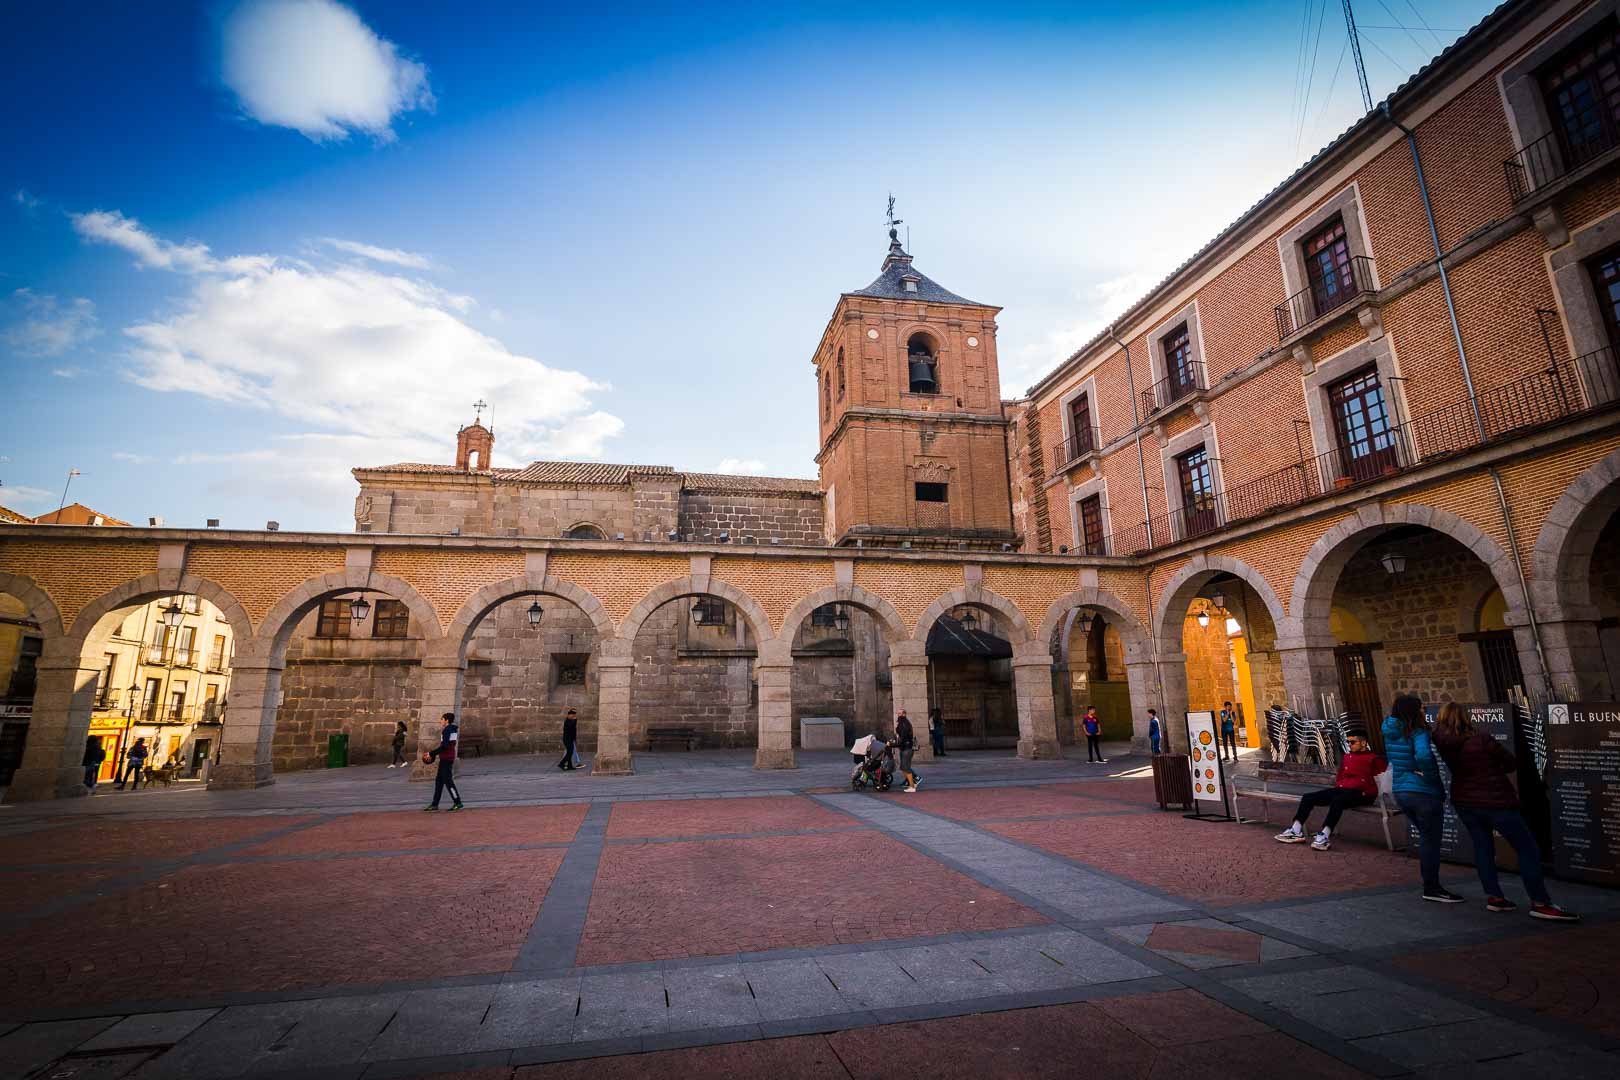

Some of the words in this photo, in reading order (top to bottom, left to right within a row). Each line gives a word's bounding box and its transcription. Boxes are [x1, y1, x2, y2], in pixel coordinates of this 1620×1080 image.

[1425, 714, 1434, 723] EL
[1470, 714, 1504, 723] ANTAR
[1573, 712, 1585, 722] EL
